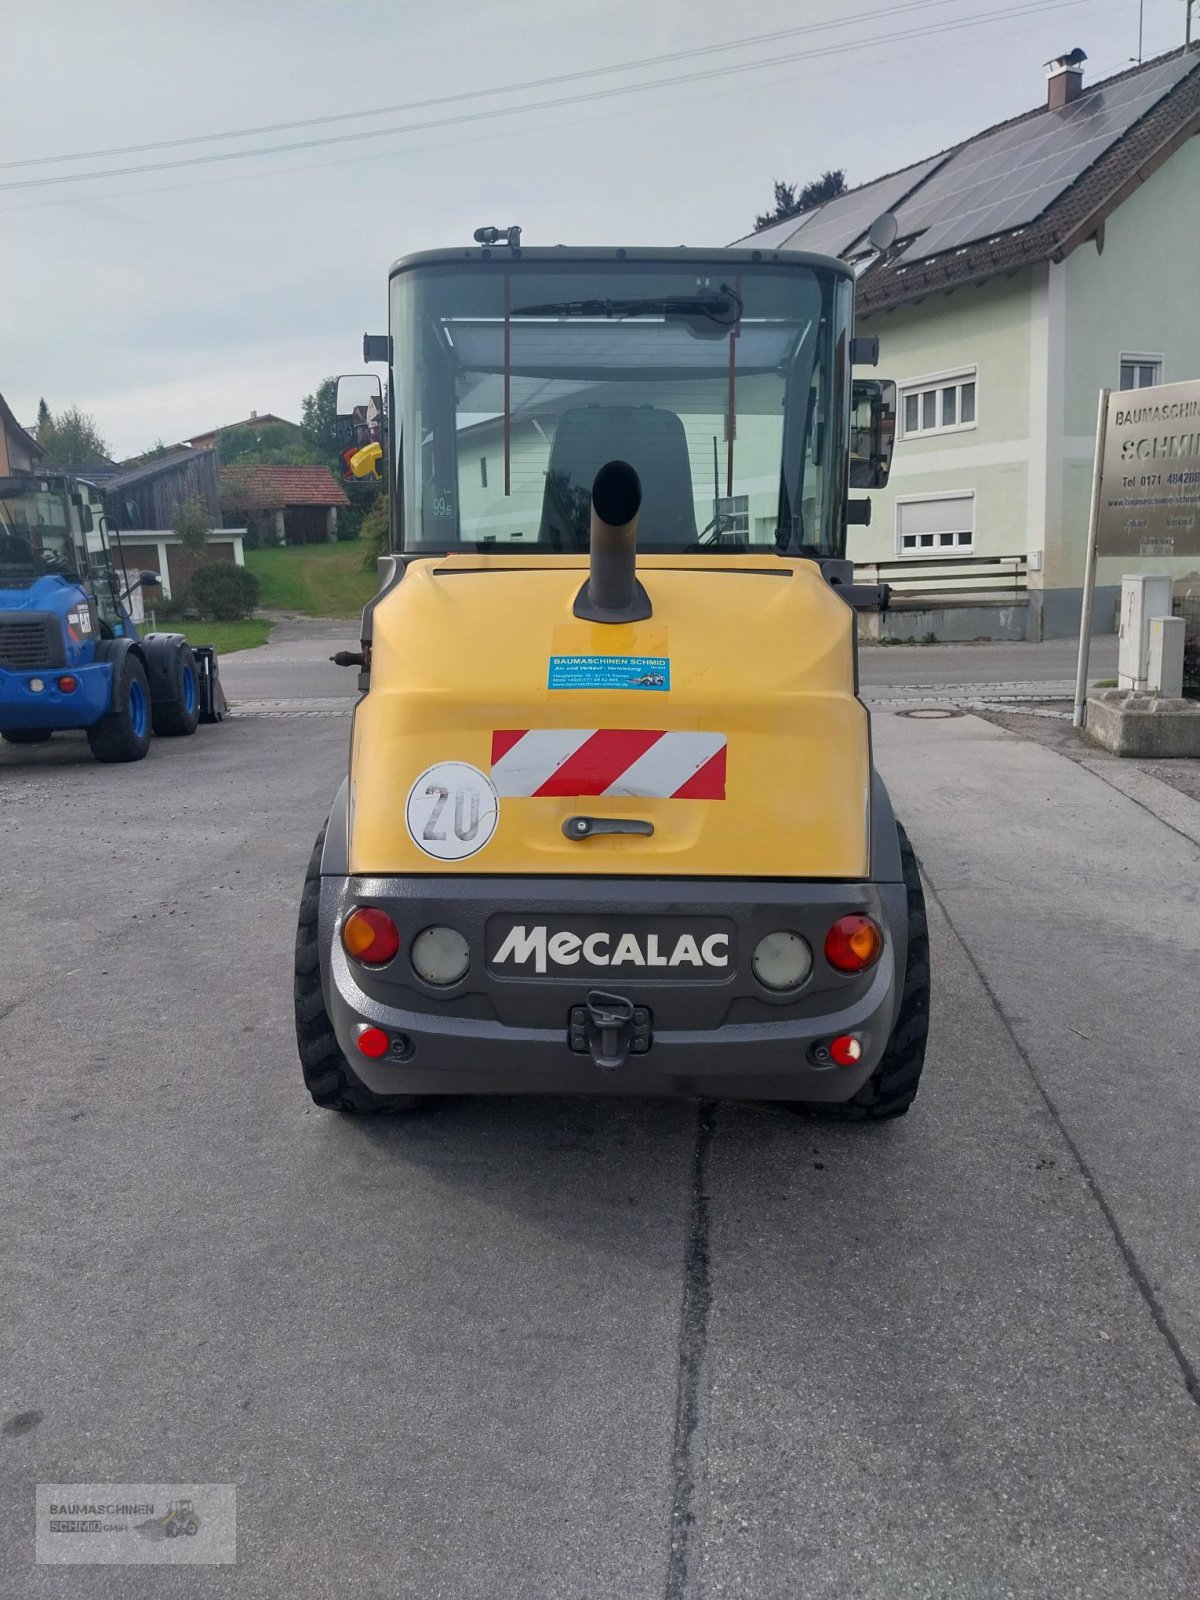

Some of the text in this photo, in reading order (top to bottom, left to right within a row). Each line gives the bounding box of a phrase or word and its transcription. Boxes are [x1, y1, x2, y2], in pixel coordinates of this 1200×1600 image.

[1121, 433, 1200, 461] SCHMI
[1122, 476, 1136, 488] Tel
[1140, 475, 1161, 486] 0171
[422, 784, 480, 842] 20
